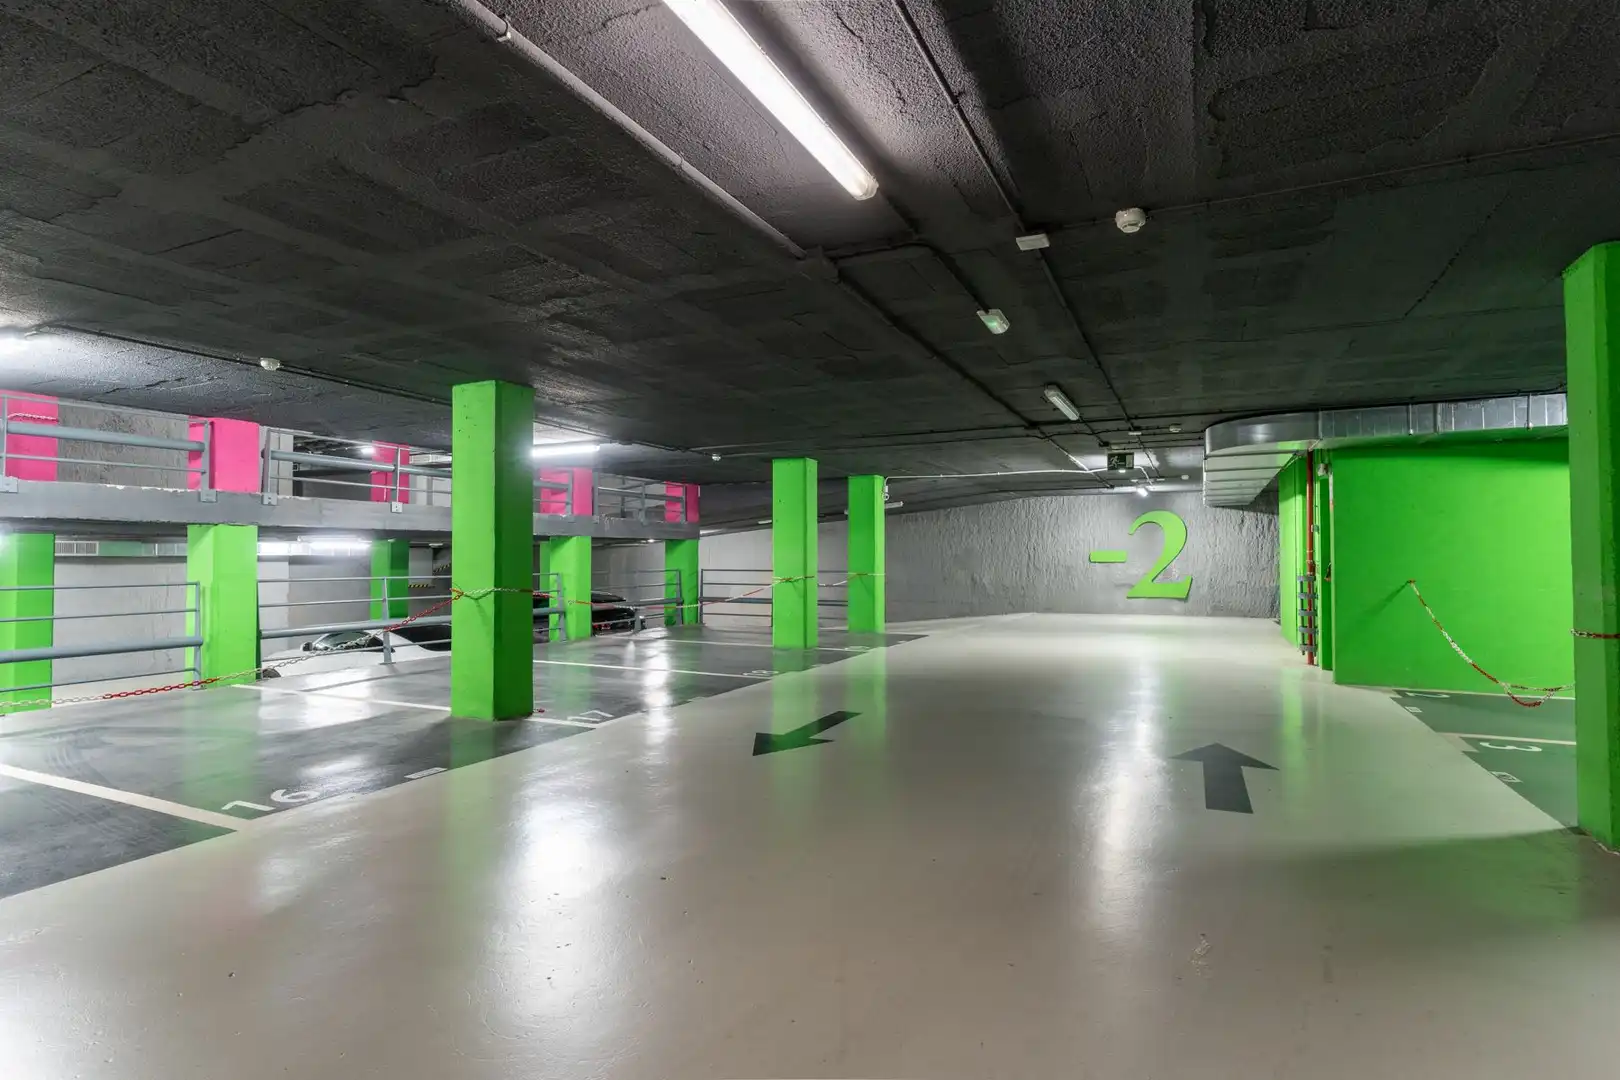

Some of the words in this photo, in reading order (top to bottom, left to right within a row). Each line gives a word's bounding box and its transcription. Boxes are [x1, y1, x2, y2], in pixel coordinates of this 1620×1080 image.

[1089, 510, 1193, 602] -2
[567, 709, 614, 721] 17
[1479, 741, 1542, 752] 3
[221, 789, 320, 812] 16
